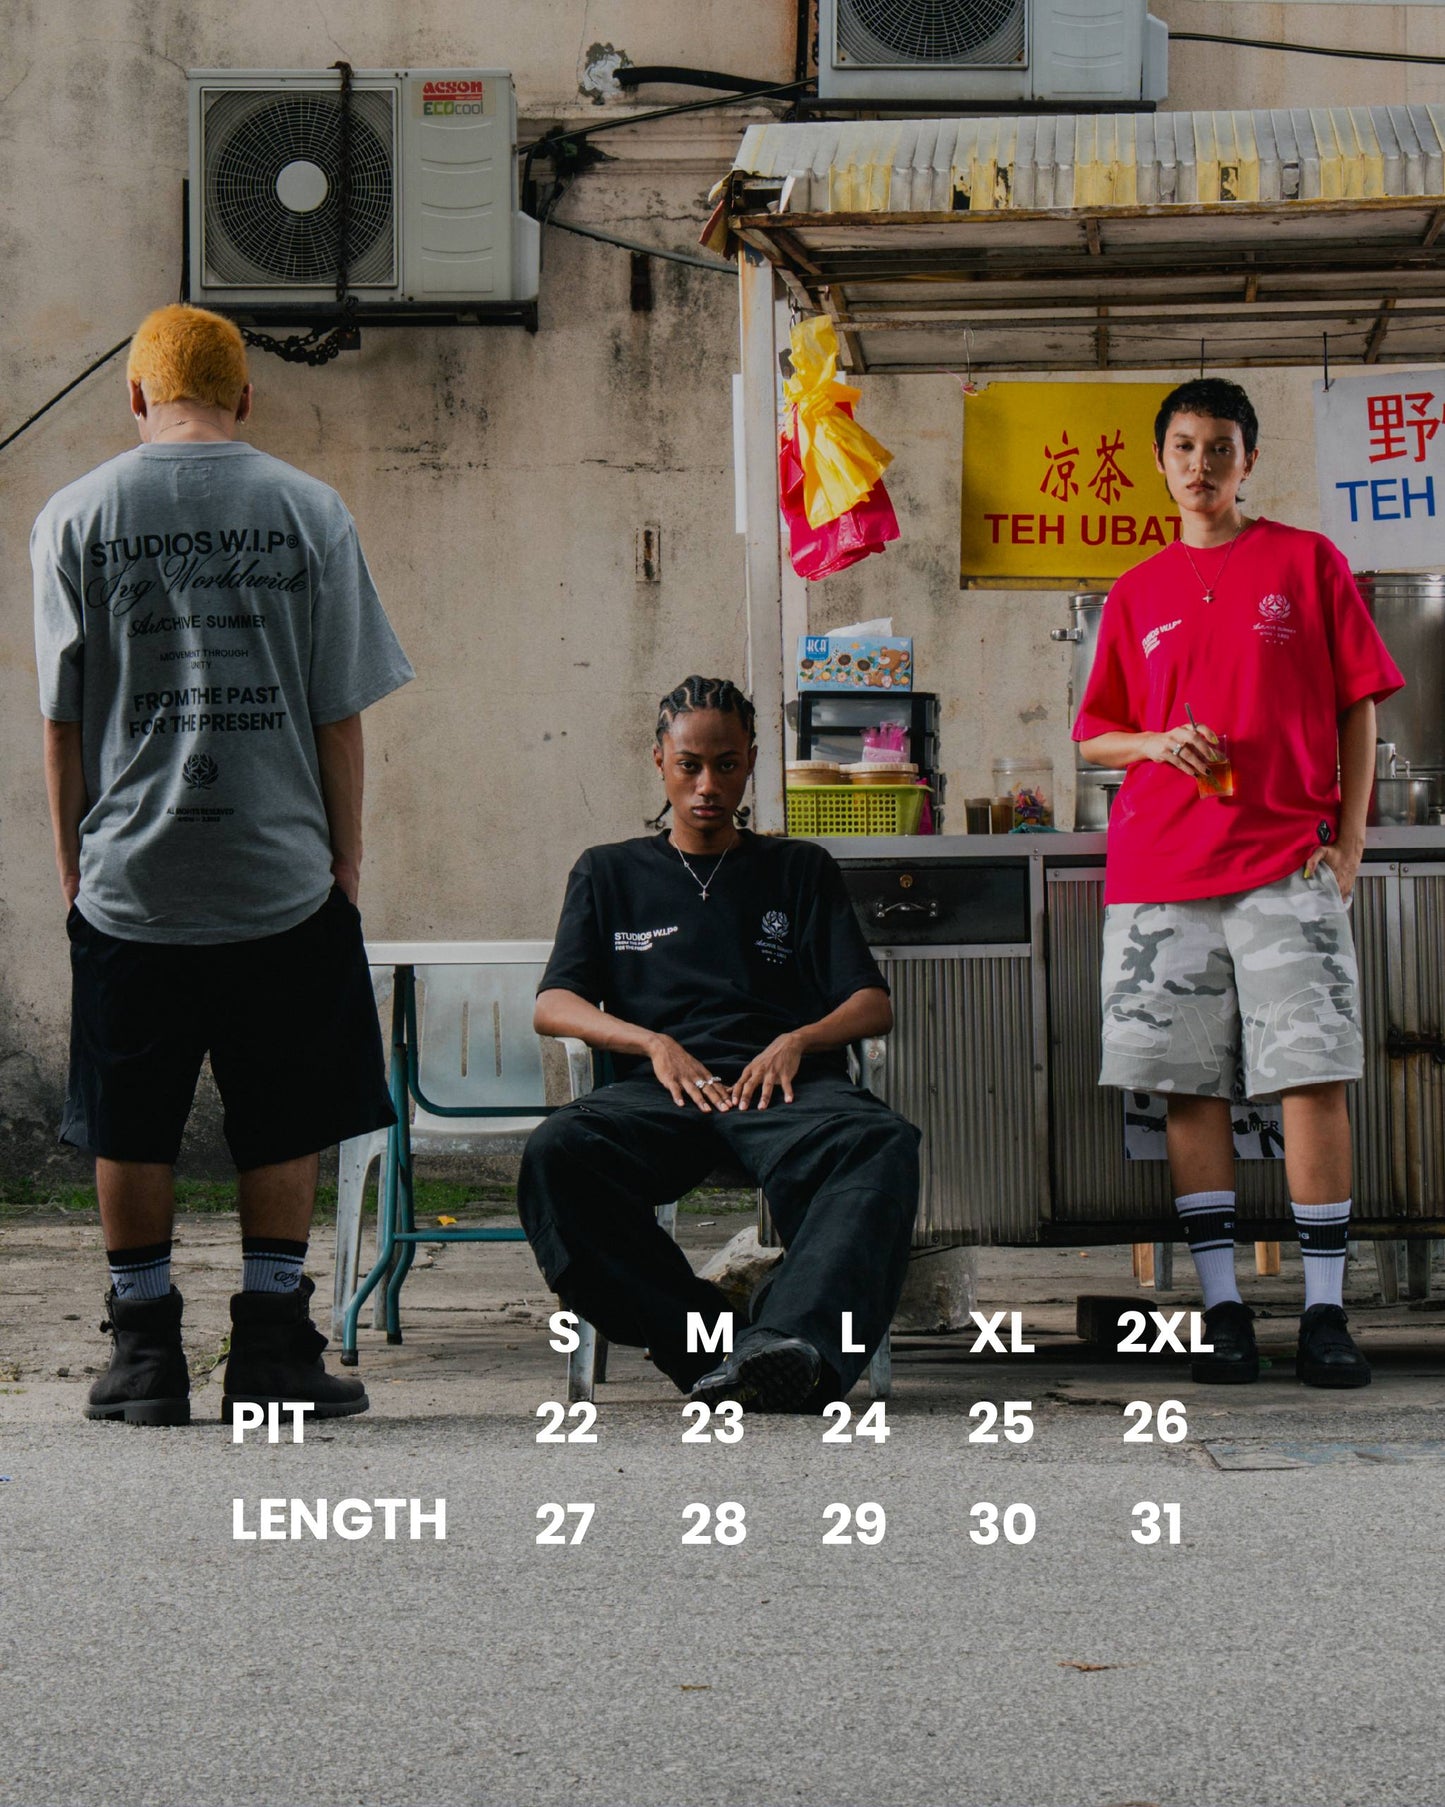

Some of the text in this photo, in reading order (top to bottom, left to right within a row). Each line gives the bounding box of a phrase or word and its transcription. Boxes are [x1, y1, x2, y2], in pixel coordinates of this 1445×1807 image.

[1367, 392, 1445, 463] 野
[1039, 429, 1134, 505] 凉茶
[1335, 476, 1435, 522] TEH
[984, 514, 1064, 544] TEH
[91, 531, 212, 568] STUDIOS
[163, 543, 308, 594] Worldwide
[206, 615, 266, 629] SUMMER
[203, 649, 249, 659] THROUGH
[133, 686, 279, 712] FROM THE PAST
[129, 712, 286, 738] FOR THE PRESENT
[614, 932, 652, 941] STUDIOS
